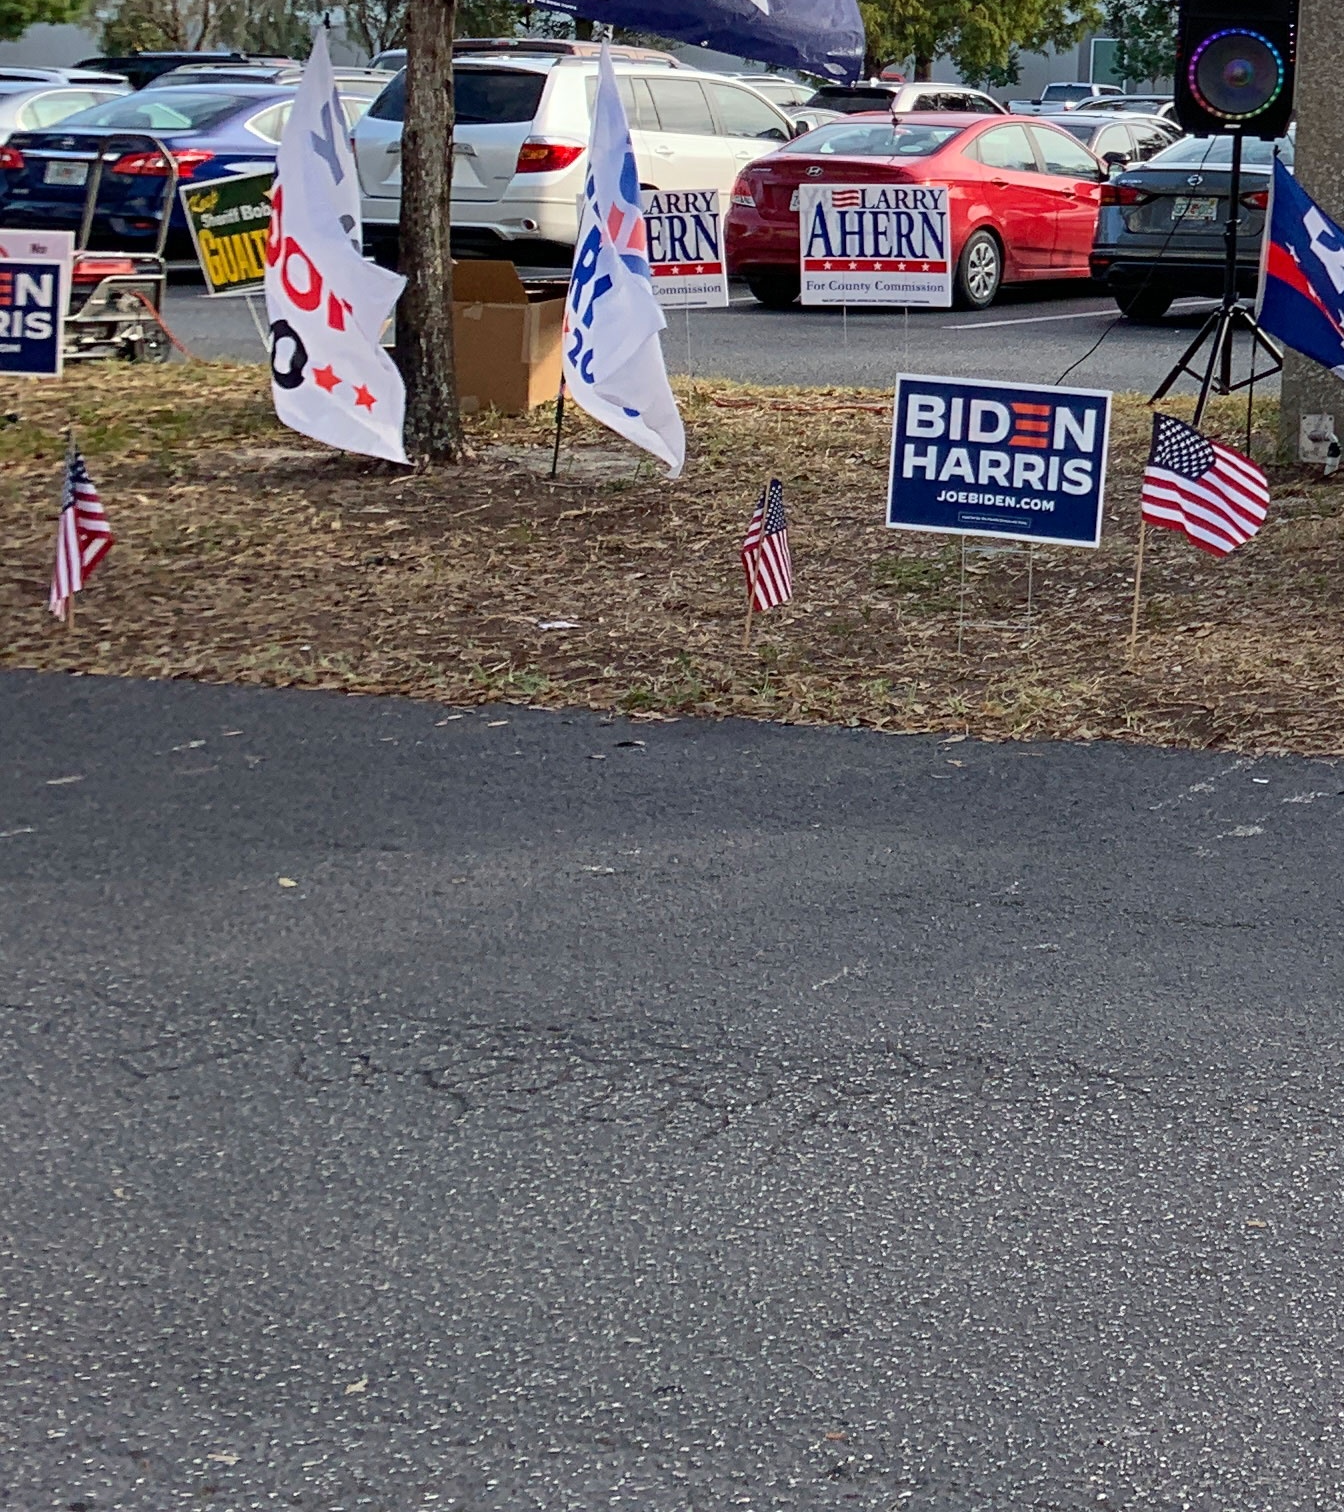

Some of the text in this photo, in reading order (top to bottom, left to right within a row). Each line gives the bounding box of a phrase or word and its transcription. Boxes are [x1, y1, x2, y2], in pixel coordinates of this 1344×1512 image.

[643, 192, 716, 216] ARRY
[859, 189, 944, 210] LARRY
[644, 214, 719, 263] ERN
[803, 200, 946, 259] AHERN
[806, 281, 944, 293] For County Commission
[905, 394, 1097, 453] BIDEN
[902, 443, 1093, 496] HARRIS
[937, 490, 1055, 512] JOEBIDEN.COM
